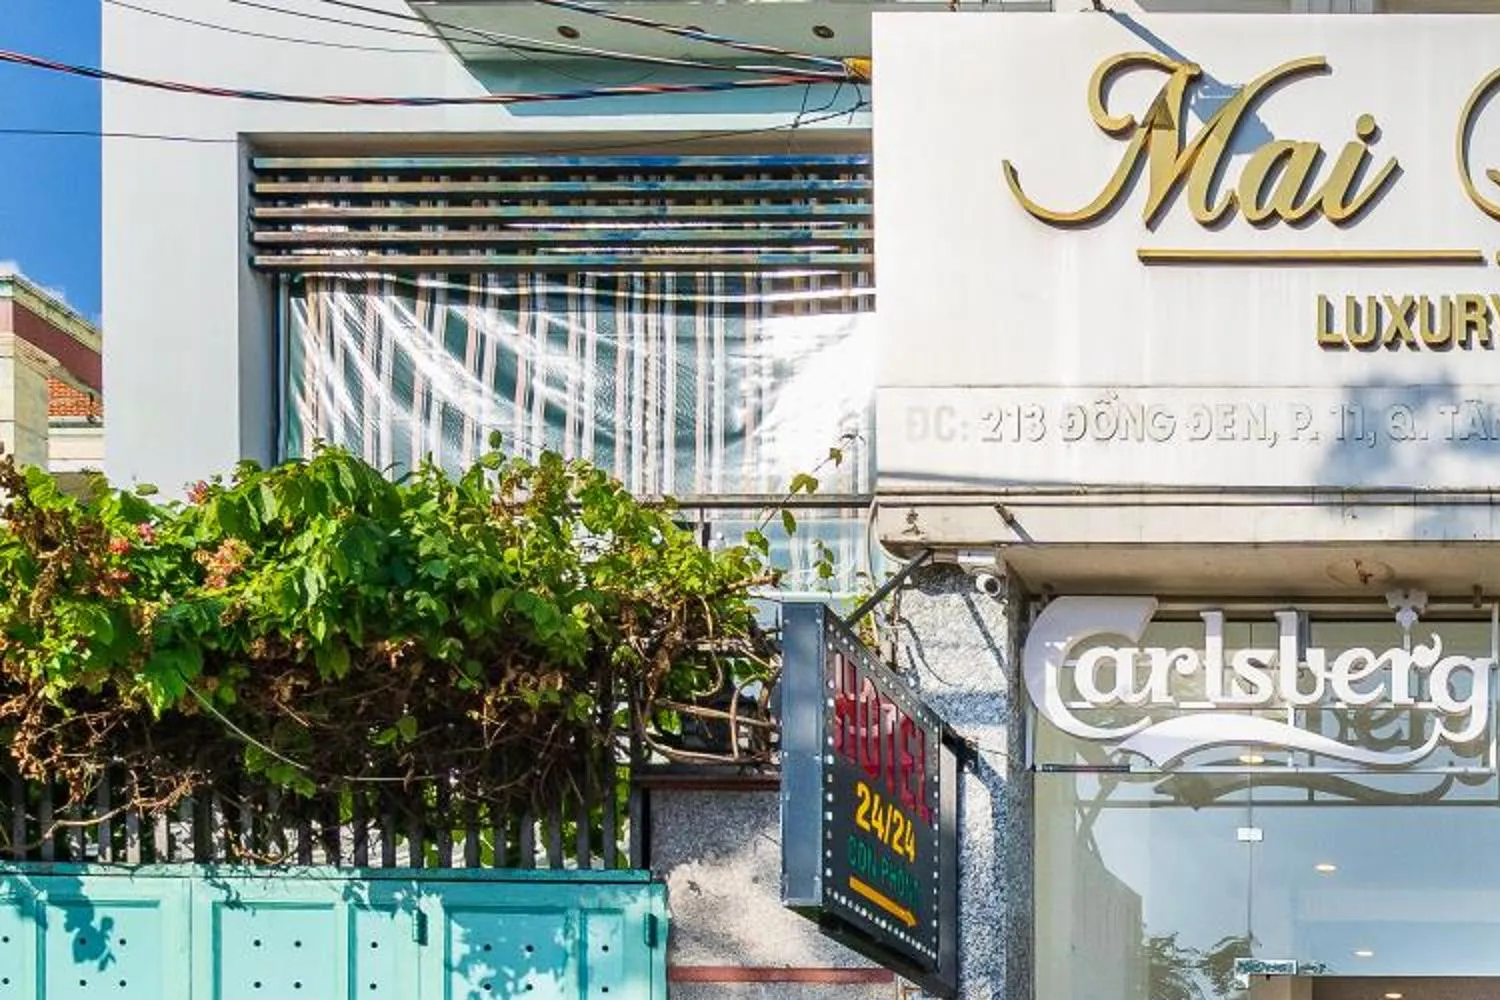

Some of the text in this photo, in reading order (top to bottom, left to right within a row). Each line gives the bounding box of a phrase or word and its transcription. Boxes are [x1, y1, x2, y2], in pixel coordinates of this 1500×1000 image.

[1002, 51, 1402, 231] Mai
[982, 404, 1046, 443] 213
[1186, 404, 1279, 448] ĐEN,
[834, 652, 934, 828] HOTEL
[1023, 595, 1498, 745] Carlsberg
[855, 781, 917, 868] 24/24
